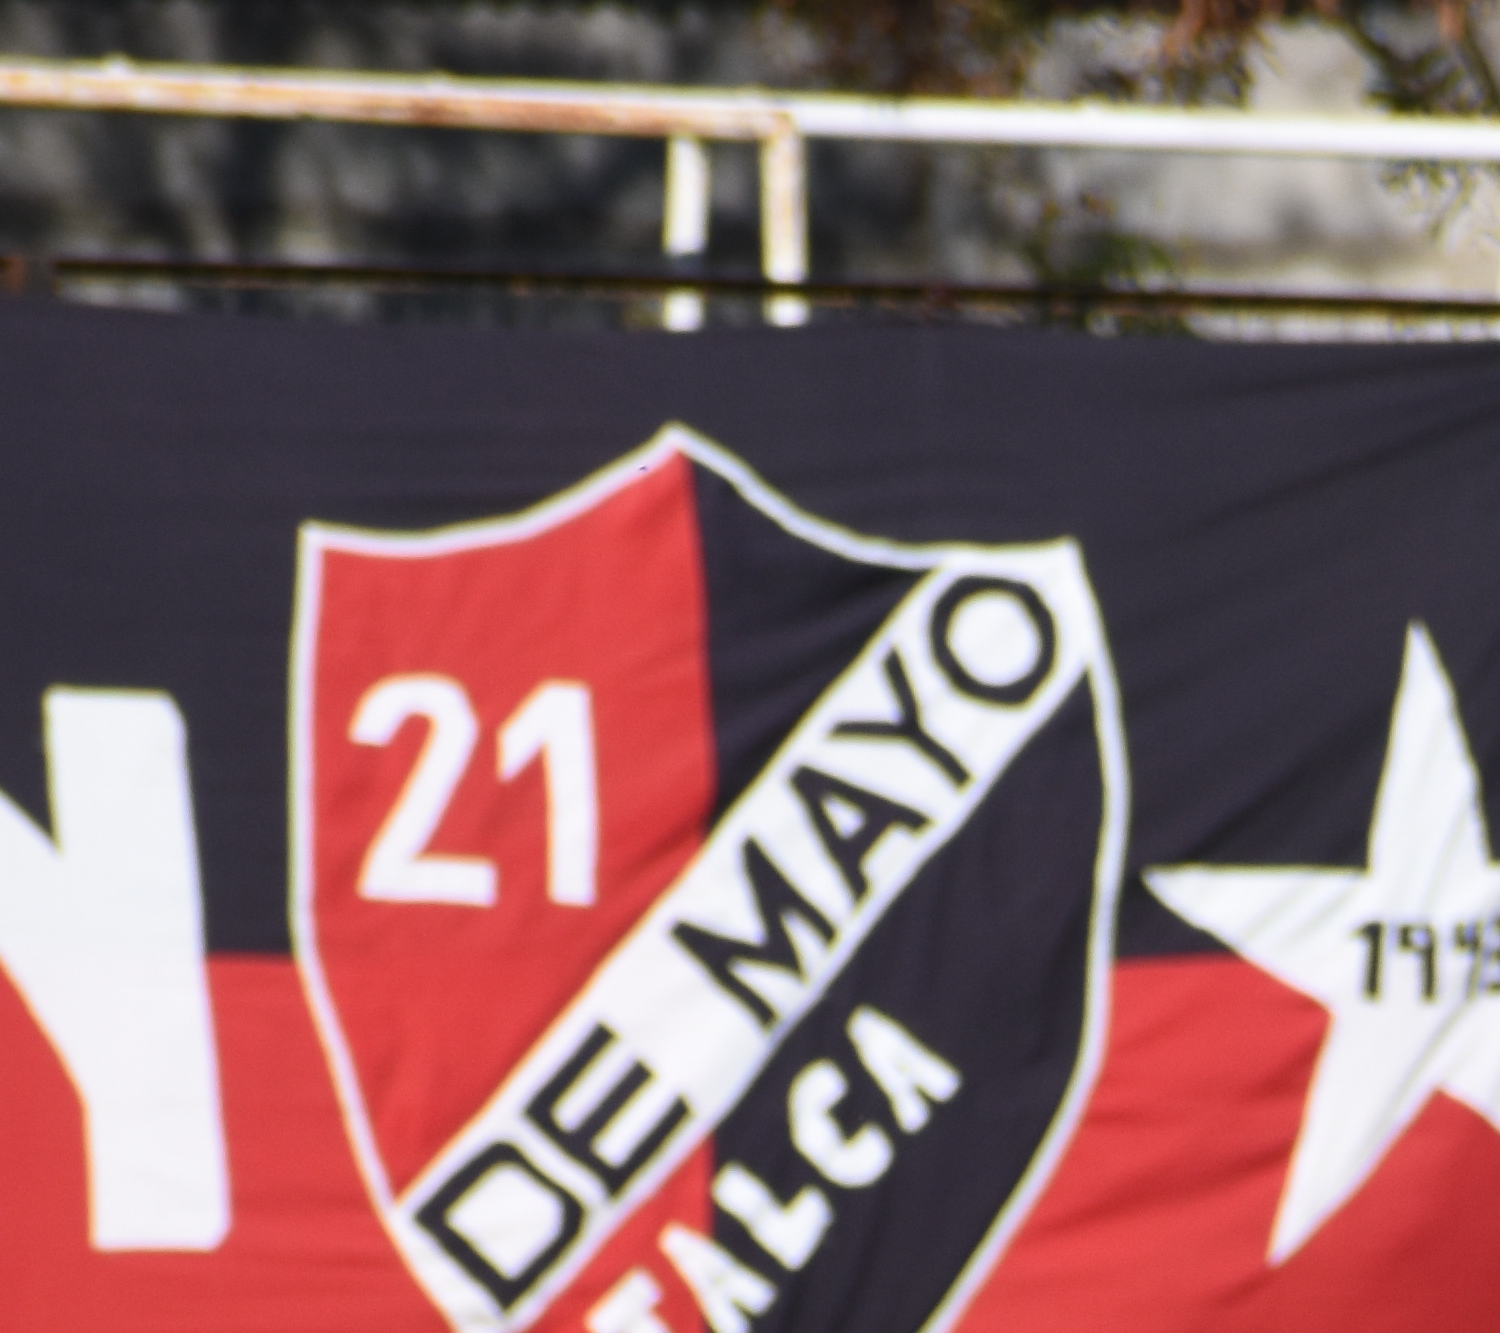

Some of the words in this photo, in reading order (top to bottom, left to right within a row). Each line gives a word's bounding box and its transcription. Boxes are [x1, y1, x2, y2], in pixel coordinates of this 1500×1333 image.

[345, 672, 598, 905] 21
[412, 1020, 693, 1318] DE
[669, 572, 1058, 1040] MAYO
